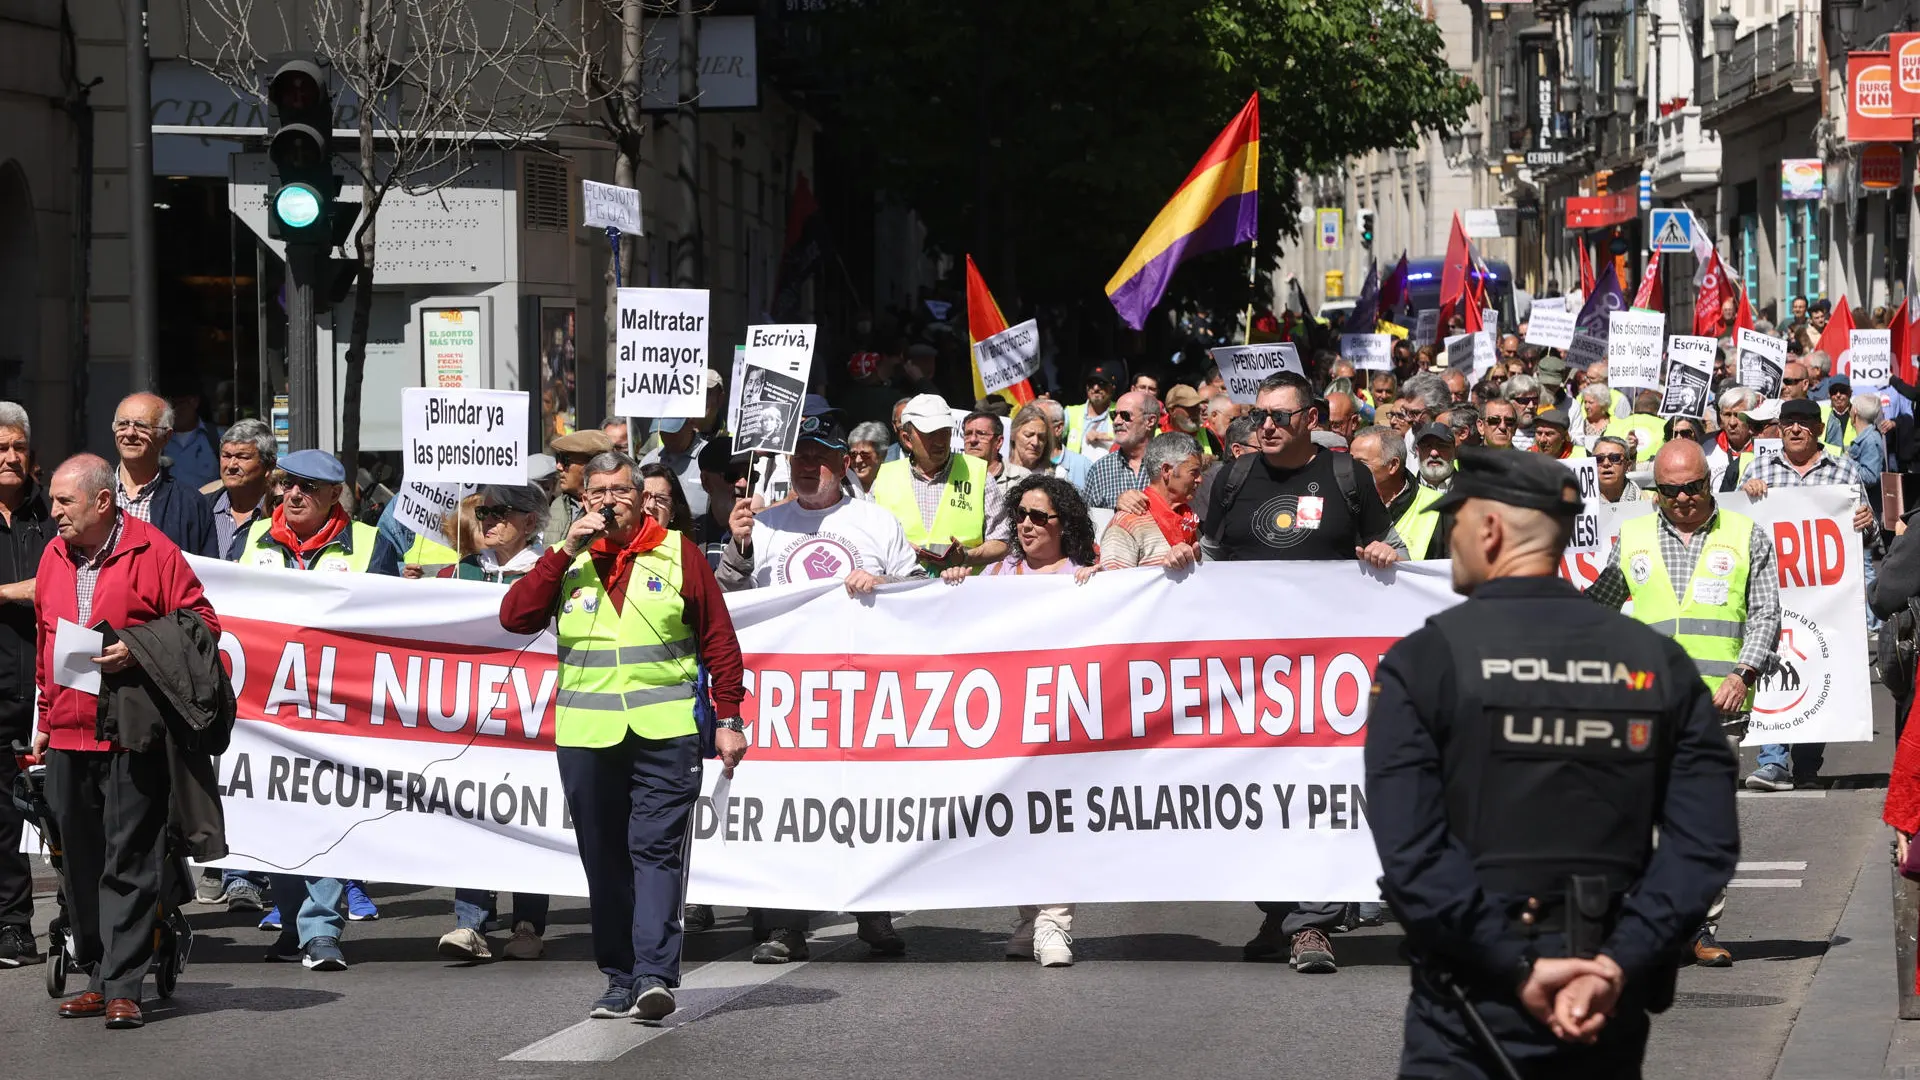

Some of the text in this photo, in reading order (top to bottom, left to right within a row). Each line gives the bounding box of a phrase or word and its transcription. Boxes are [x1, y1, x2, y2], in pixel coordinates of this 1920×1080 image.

[1859, 83, 1891, 92] BURG
[1538, 80, 1552, 149] HOSTAL
[585, 182, 635, 206] PENSION
[588, 202, 633, 224] IGUAL
[621, 308, 704, 332] Maltratar
[1611, 320, 1661, 337] Nos discriminan
[620, 341, 704, 369] al mayor,
[1610, 346, 1614, 356] a
[1615, 343, 1626, 356] los
[1852, 353, 1860, 363] de
[1231, 351, 1285, 375] ¡PENSIONES
[1609, 367, 1621, 380] que
[1852, 368, 1889, 380] NO!
[621, 369, 701, 398] ¡JAMÁS!
[425, 398, 504, 432] ¡Blindar ya
[413, 438, 518, 472] las pensiones!
[953, 480, 972, 496] NO
[958, 493, 967, 501] AL
[402, 494, 413, 516] TU
[950, 498, 973, 512] 0.25%
[1773, 518, 1845, 588] RID
[1783, 609, 1830, 660] por la Defensa
[1481, 658, 1633, 686] POLICIA
[263, 641, 347, 723] AL
[1021, 661, 1104, 745] EN
[1128, 651, 1384, 738] PENSIO
[1792, 715, 1805, 728] de
[1804, 673, 1832, 720] Pensiones
[1503, 715, 1622, 748] U.I.P.
[267, 755, 549, 828] RECUPERACIÓN
[774, 792, 1014, 848] ADQUISITIVO
[1027, 788, 1075, 835] DE
[1087, 782, 1264, 833] SALARIOS
[1273, 784, 1296, 829] Y
